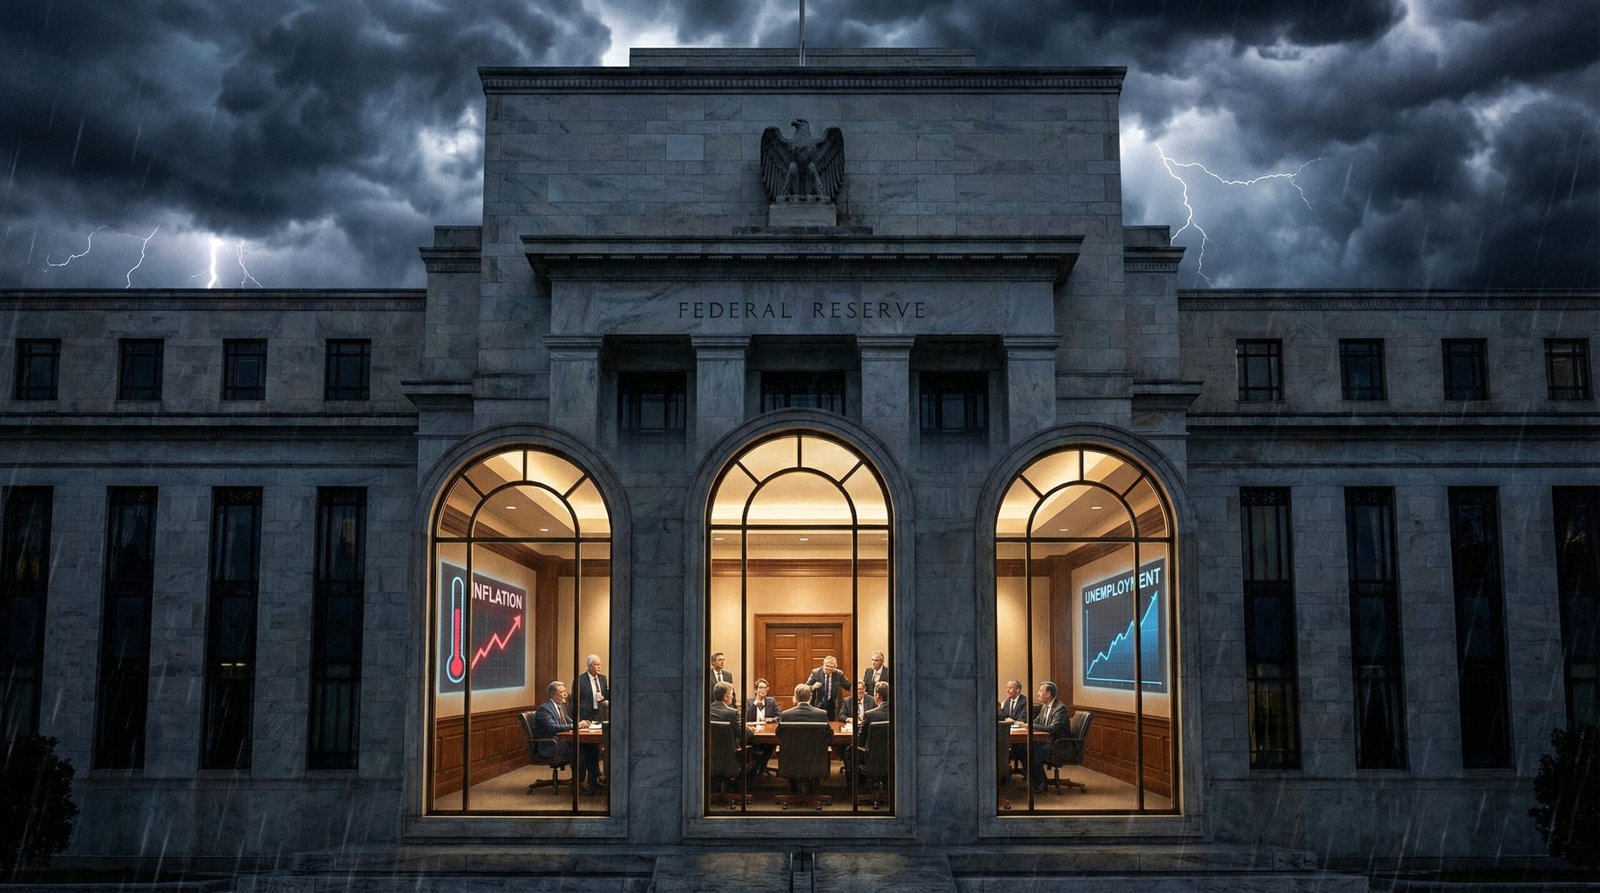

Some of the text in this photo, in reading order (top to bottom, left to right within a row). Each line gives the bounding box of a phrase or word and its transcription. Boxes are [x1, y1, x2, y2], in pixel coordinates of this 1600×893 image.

[678, 302, 926, 319] FEDERAL RESERVE
[472, 582, 522, 609] INFLATION
